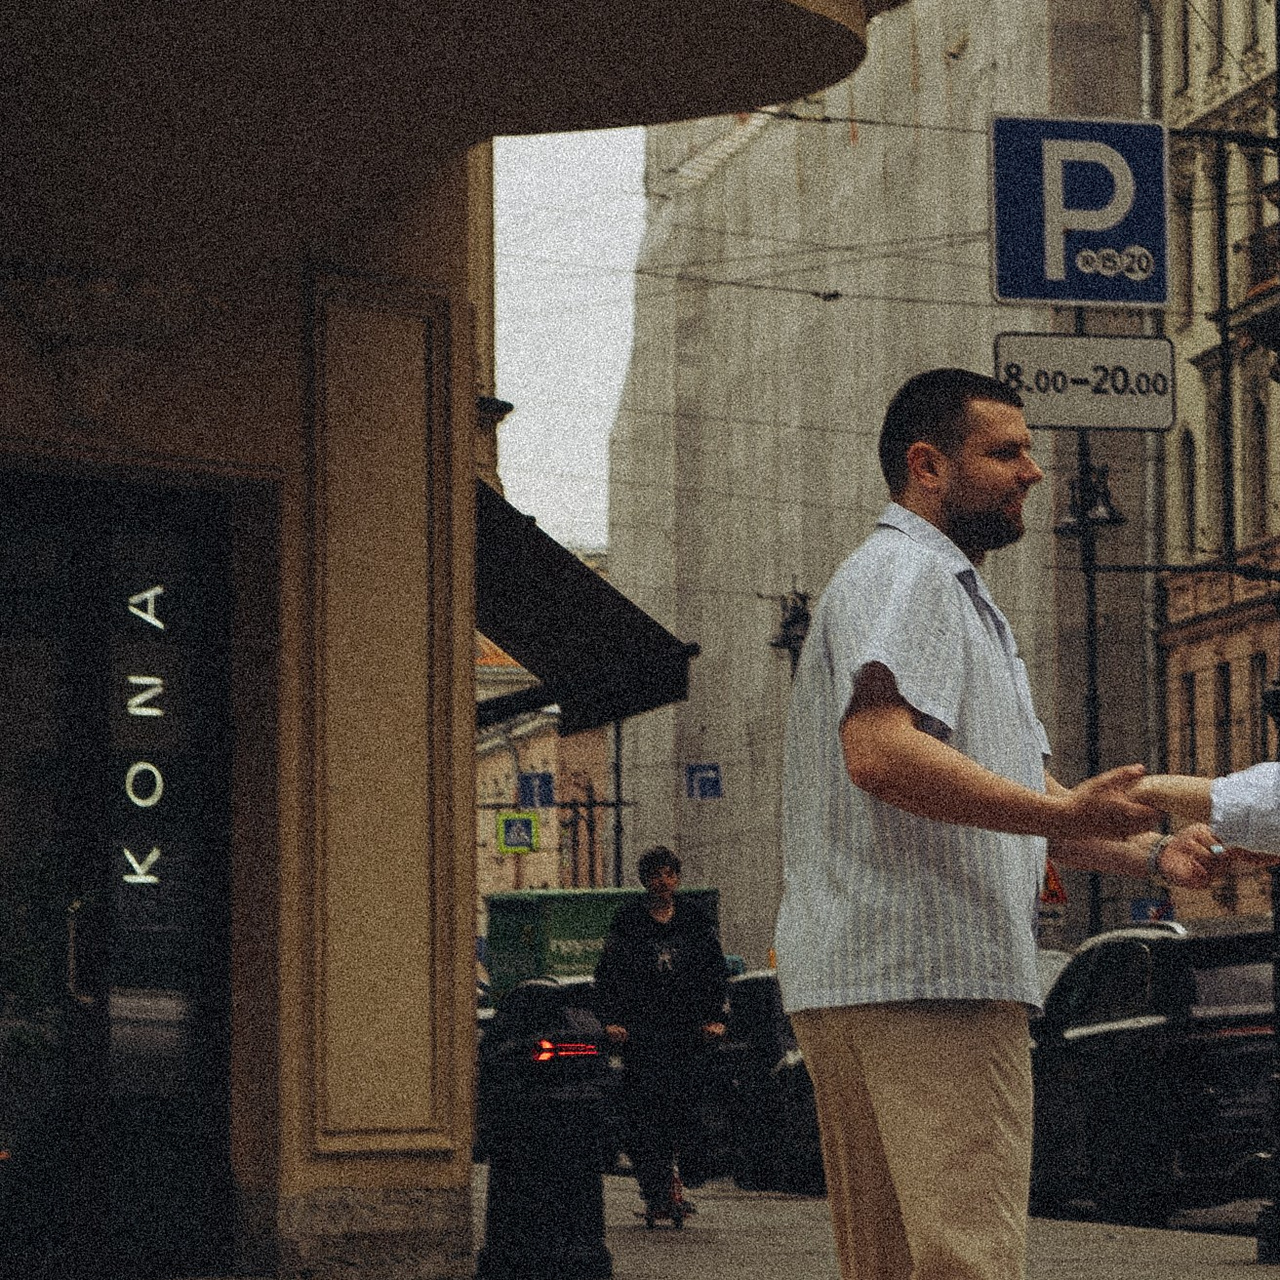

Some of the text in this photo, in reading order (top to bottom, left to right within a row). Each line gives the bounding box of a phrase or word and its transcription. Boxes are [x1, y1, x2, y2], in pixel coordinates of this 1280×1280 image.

[1043, 139, 1135, 281] P
[1124, 252, 1151, 274] 20
[122, 586, 165, 884] KONA
